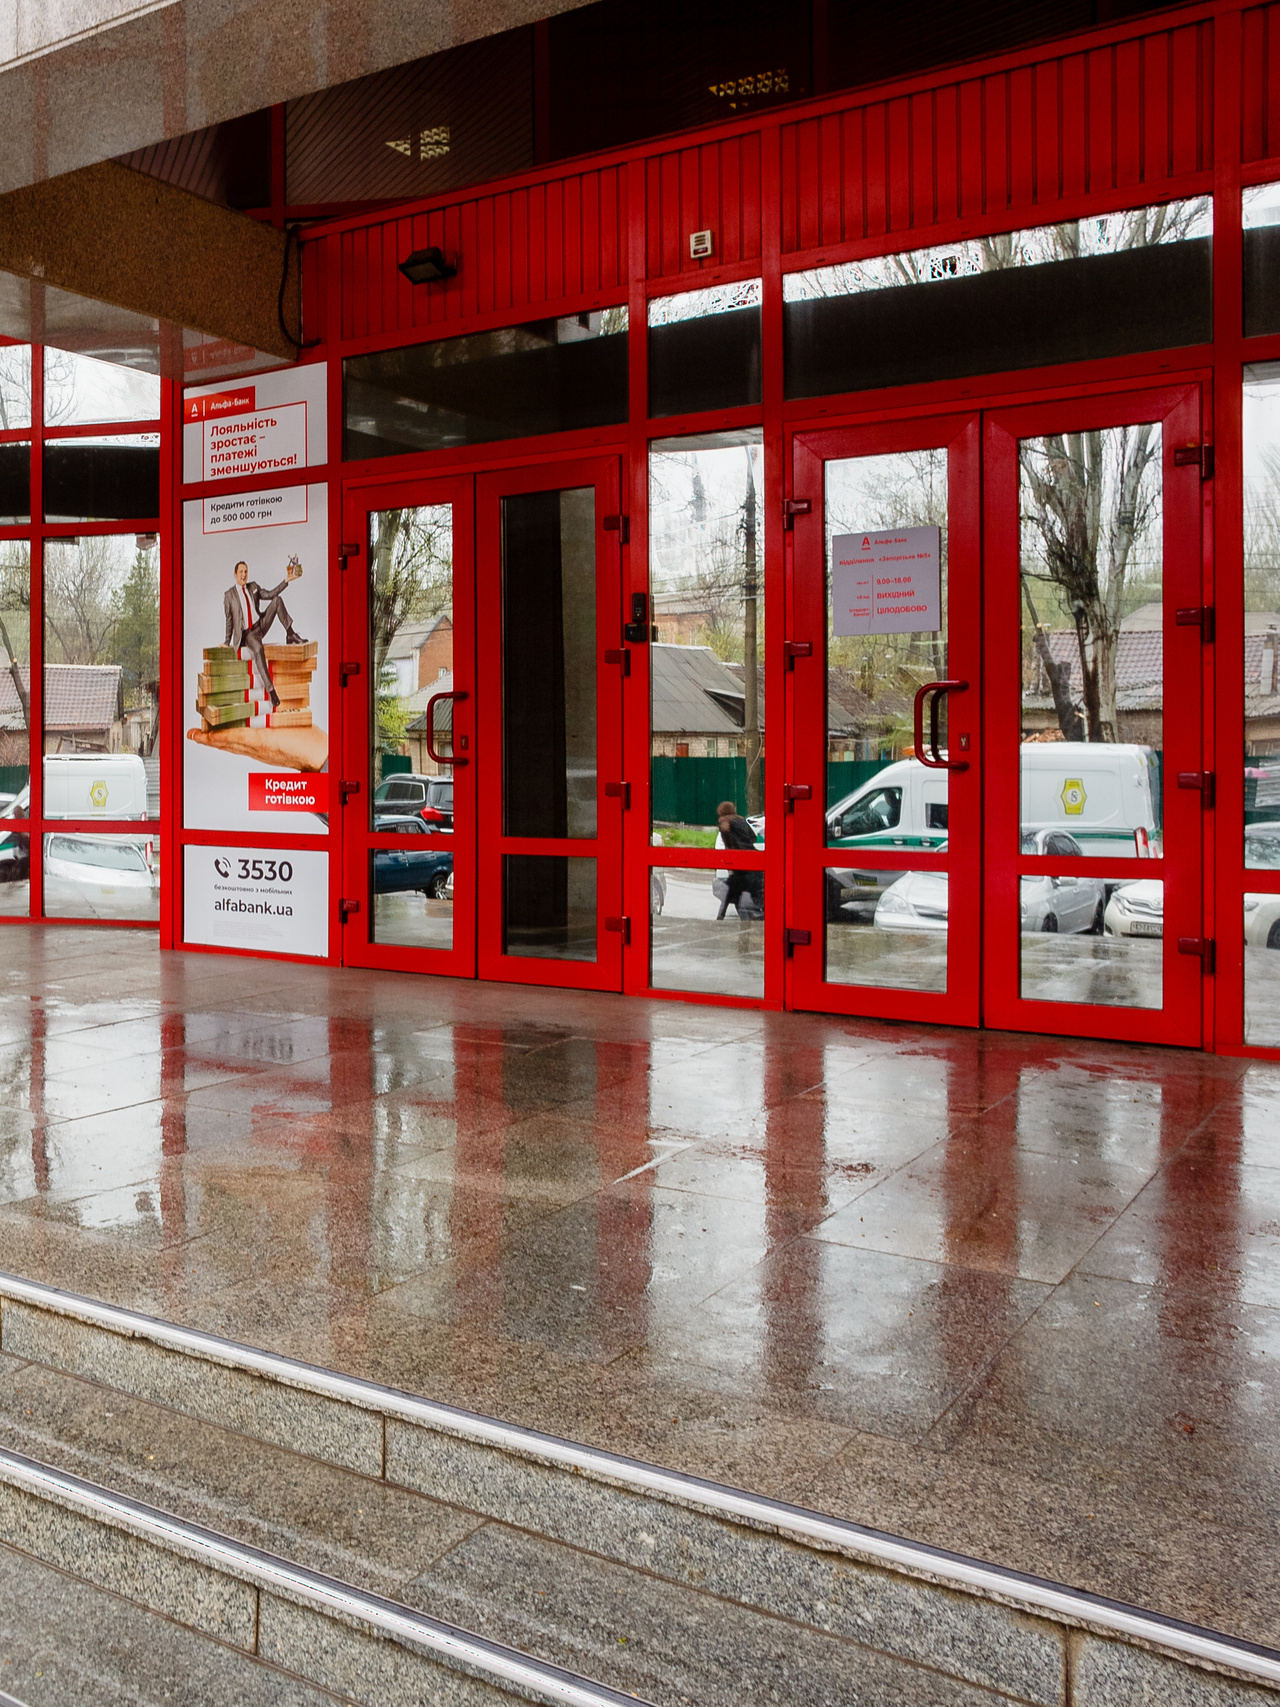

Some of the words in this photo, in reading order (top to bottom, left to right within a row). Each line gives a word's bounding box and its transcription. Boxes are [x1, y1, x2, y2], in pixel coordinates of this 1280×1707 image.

[210, 417, 278, 438] Лояльність
[210, 434, 257, 451] зростає
[210, 445, 258, 463] платежі
[210, 453, 297, 477] зменшуються!
[210, 501, 244, 512] Кредити
[246, 496, 283, 507] готівкою
[210, 517, 221, 525] до
[222, 513, 238, 522] 500
[239, 510, 256, 520] 000
[257, 510, 272, 519] грн
[876, 589, 916, 600] ВИХІДНИЙ
[876, 604, 929, 615] ЦІЛОДОБОВО
[265, 778, 308, 793] Кредит
[265, 792, 316, 805] готівкою
[237, 858, 293, 882] 3530
[214, 884, 254, 893] безкоштовно
[260, 887, 293, 895] мобільних
[214, 898, 293, 917] alfabank.ua
